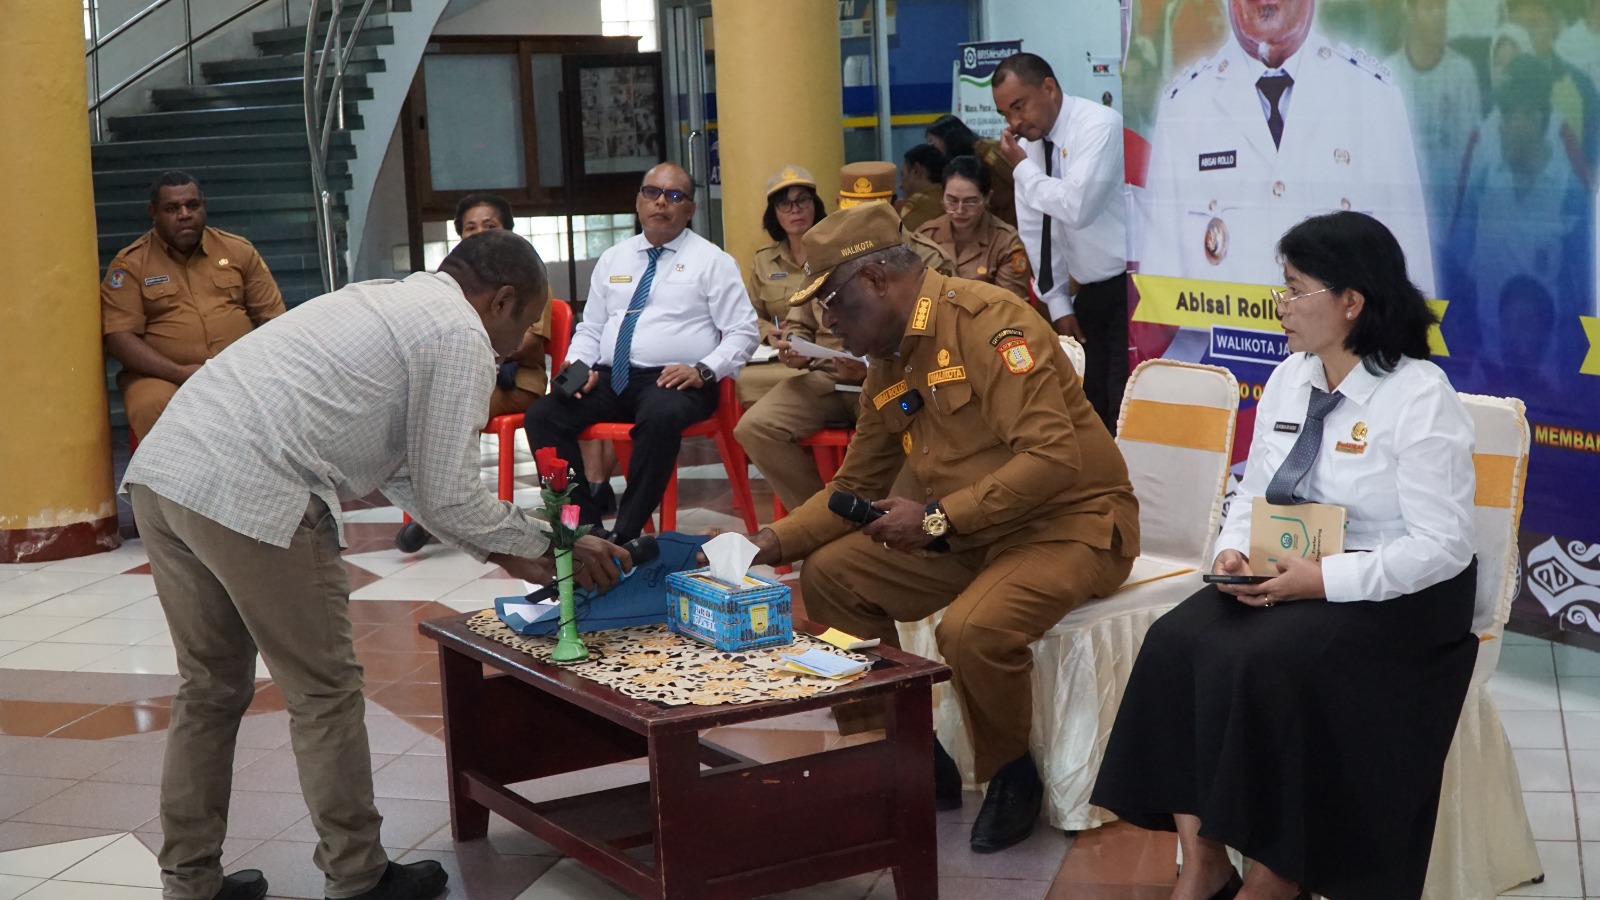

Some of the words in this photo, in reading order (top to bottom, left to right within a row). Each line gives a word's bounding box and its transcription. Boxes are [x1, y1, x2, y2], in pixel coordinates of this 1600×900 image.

[1217, 155, 1234, 166] ROLLO
[840, 239, 875, 257] WALIKOTA
[1176, 291, 1231, 316] Abisai
[1216, 334, 1275, 355] WALIKOTA
[1278, 342, 1292, 356] JA
[929, 369, 963, 384] WALIKOTA
[1535, 424, 1600, 452] MEMBA
